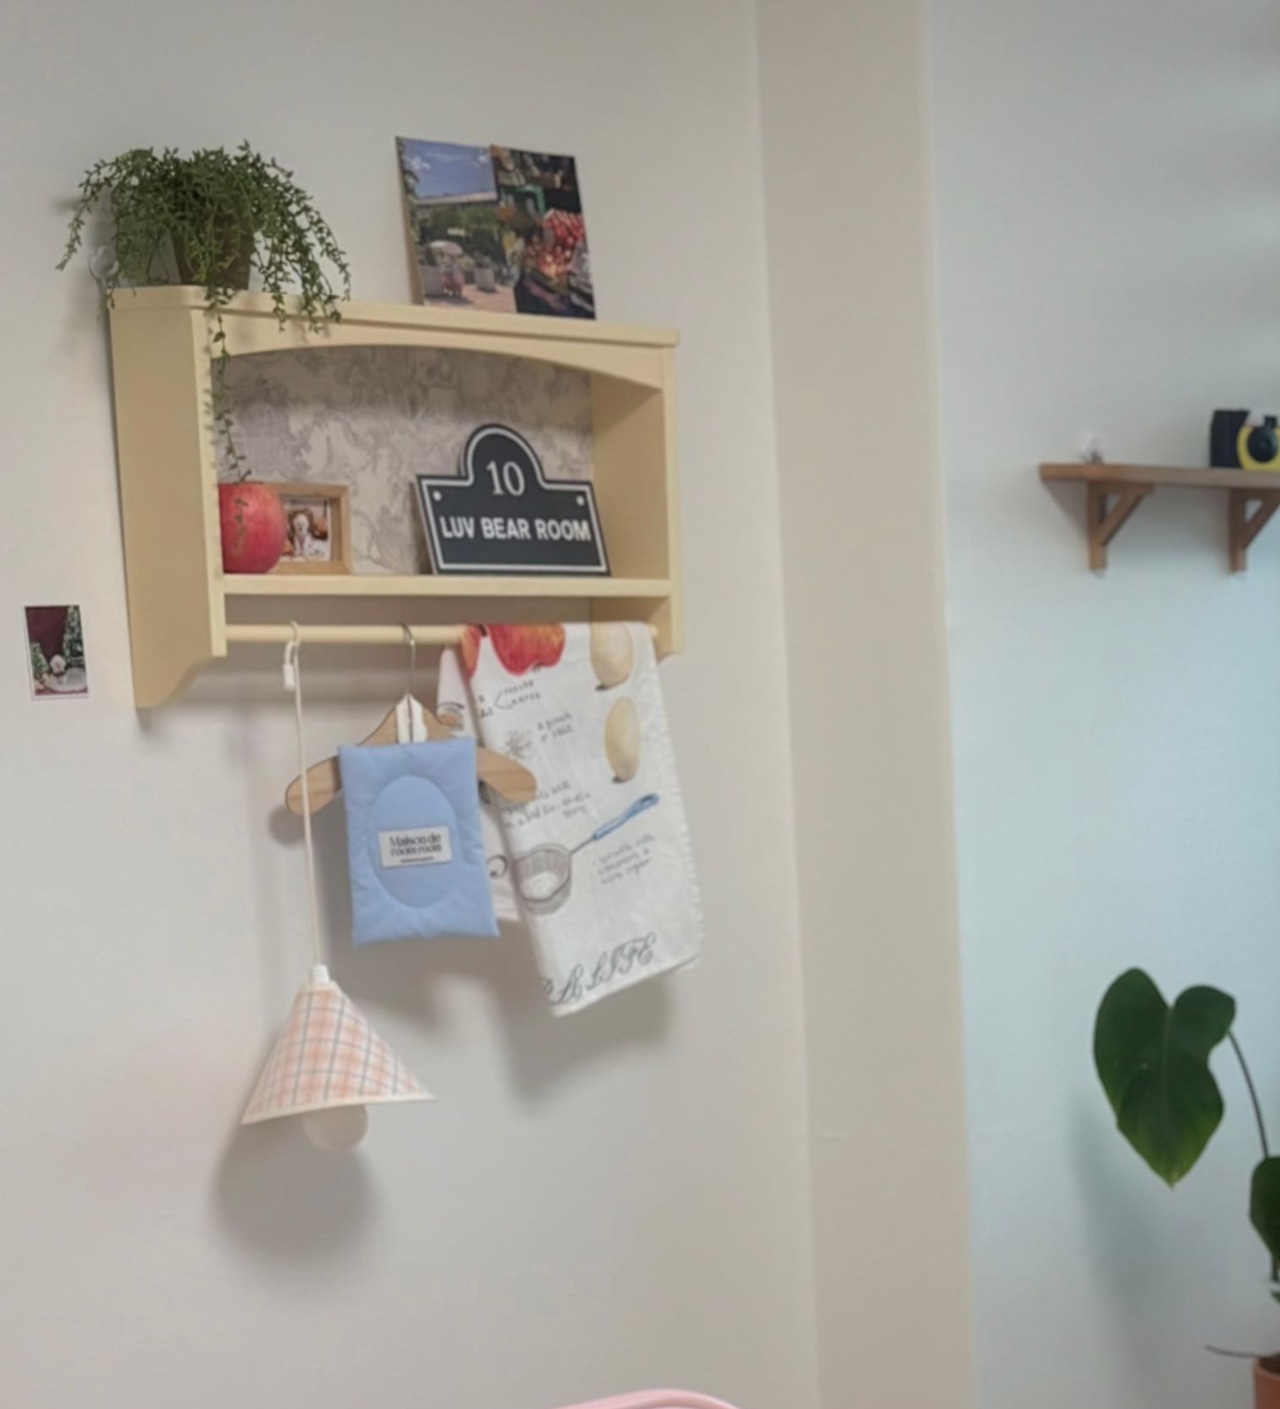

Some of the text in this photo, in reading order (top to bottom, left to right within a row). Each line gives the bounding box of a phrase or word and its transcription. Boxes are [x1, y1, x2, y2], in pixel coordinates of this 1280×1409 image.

[485, 460, 525, 496] 10
[439, 516, 592, 542] LUV BEAR ROOM
[389, 832, 442, 847] Maison de
